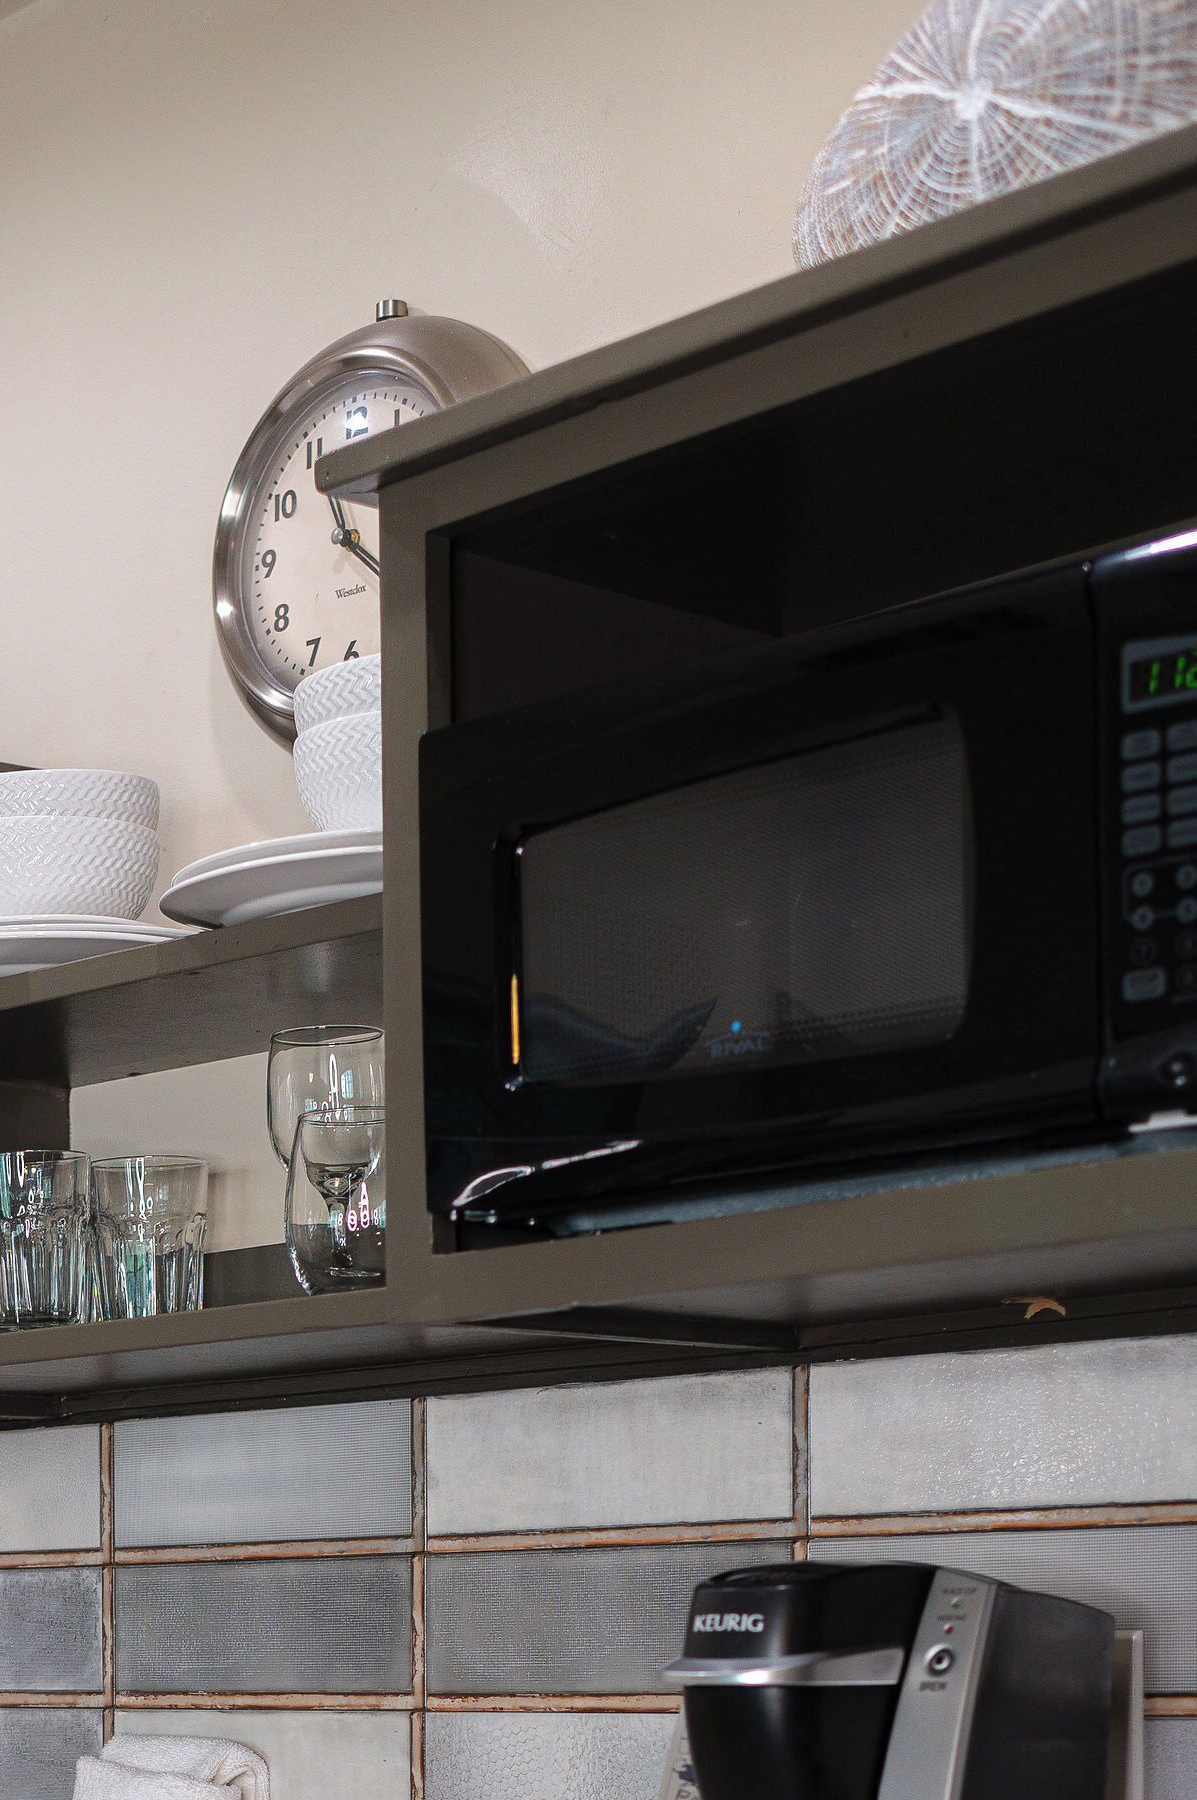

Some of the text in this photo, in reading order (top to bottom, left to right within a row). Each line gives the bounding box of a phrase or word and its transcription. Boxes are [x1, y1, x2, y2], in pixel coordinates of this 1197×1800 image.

[306, 437, 323, 471] 11
[273, 489, 298, 523] 10
[261, 549, 277, 579] 9
[335, 583, 367, 599] Westclox
[273, 603, 290, 633] 8
[305, 636, 322, 668] 7
[342, 639, 360, 662] 6
[693, 1613, 765, 1633] KEURIG
